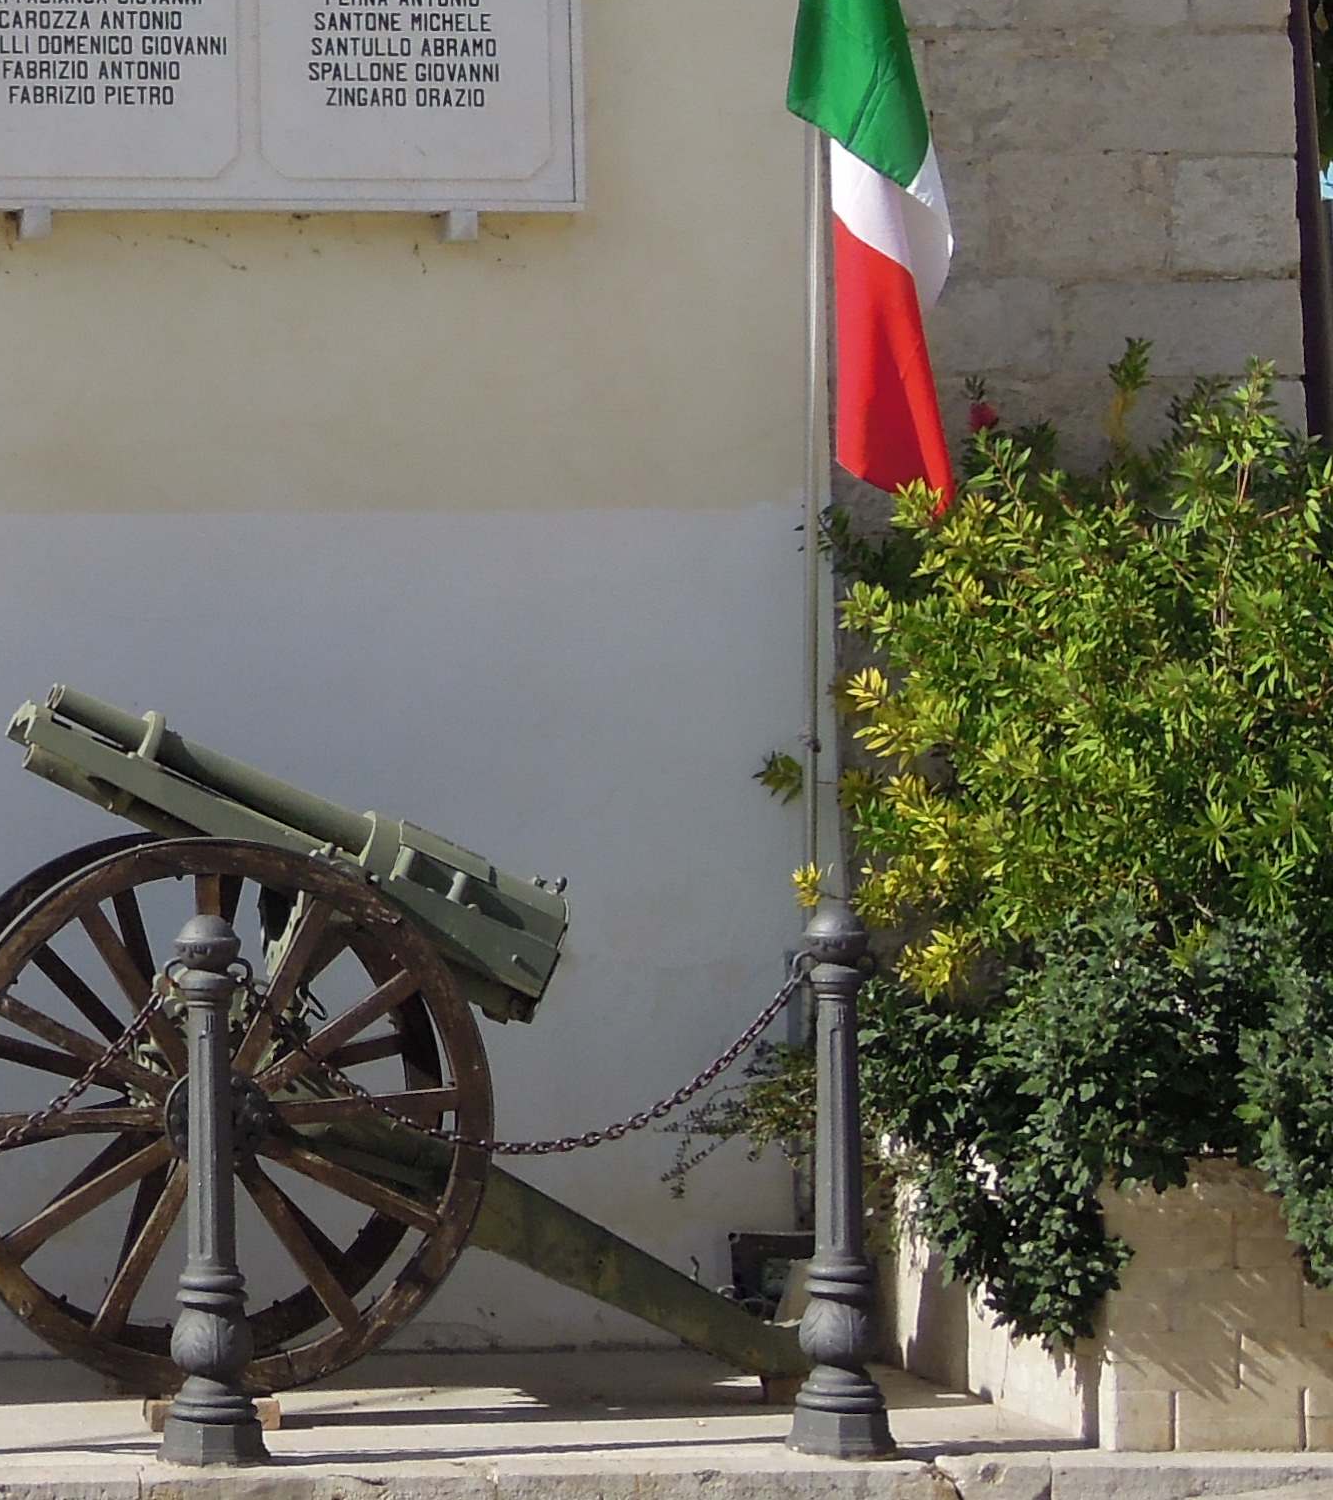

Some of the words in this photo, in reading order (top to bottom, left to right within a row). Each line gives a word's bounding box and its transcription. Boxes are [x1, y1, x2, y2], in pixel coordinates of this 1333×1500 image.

[100, 10, 182, 31] ANTONIO
[314, 11, 402, 32] SANTONE
[410, 12, 492, 32] MICHELE
[38, 34, 133, 56] DOMENICO
[141, 35, 227, 56] GIOVANNI
[311, 36, 412, 57] SANTULLO
[420, 37, 497, 58] ABRAMO
[2, 59, 89, 80] FABRIZIO
[98, 60, 180, 81] ANTONIO
[308, 61, 408, 82] SPALLONE
[415, 62, 500, 83] GIOVANNI
[8, 85, 96, 105] FABRIZIO
[104, 85, 174, 106] PIETRO
[326, 87, 407, 107] ZINGARO
[415, 87, 485, 108] ORAZIO
